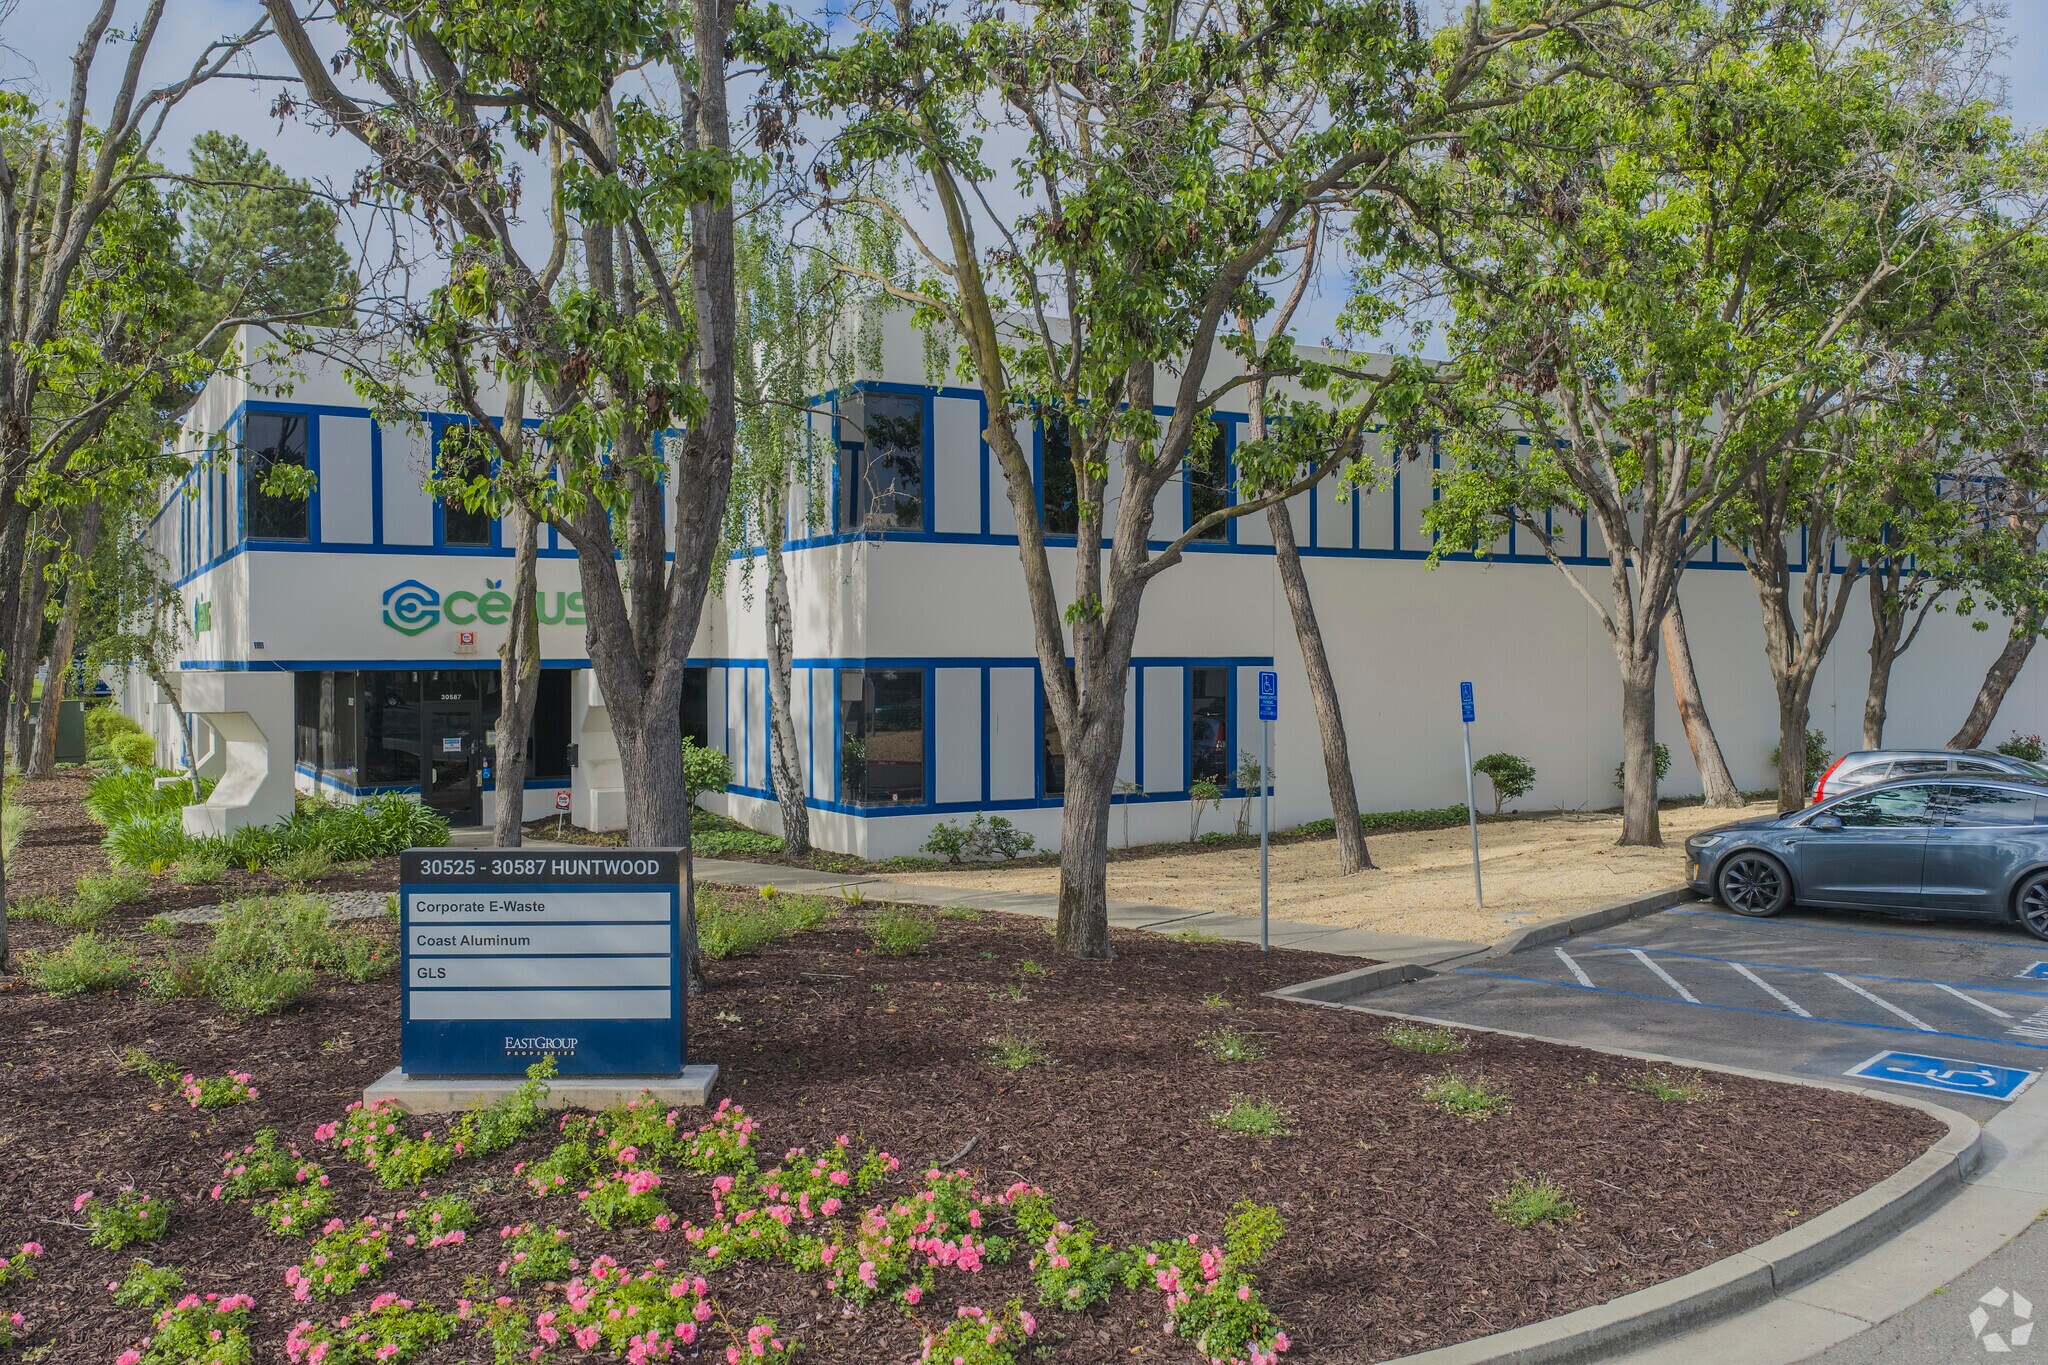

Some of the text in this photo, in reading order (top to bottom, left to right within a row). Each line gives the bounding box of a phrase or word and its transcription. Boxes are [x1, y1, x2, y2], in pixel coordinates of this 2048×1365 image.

[440, 693, 462, 701] 30587
[420, 859, 476, 876] 30525
[491, 859, 547, 876] 30587
[551, 859, 660, 876] HUNTWOOD
[416, 900, 545, 915] Corporate E-Waste
[416, 934, 531, 947] Coast Aluminum
[417, 967, 446, 979] GLS
